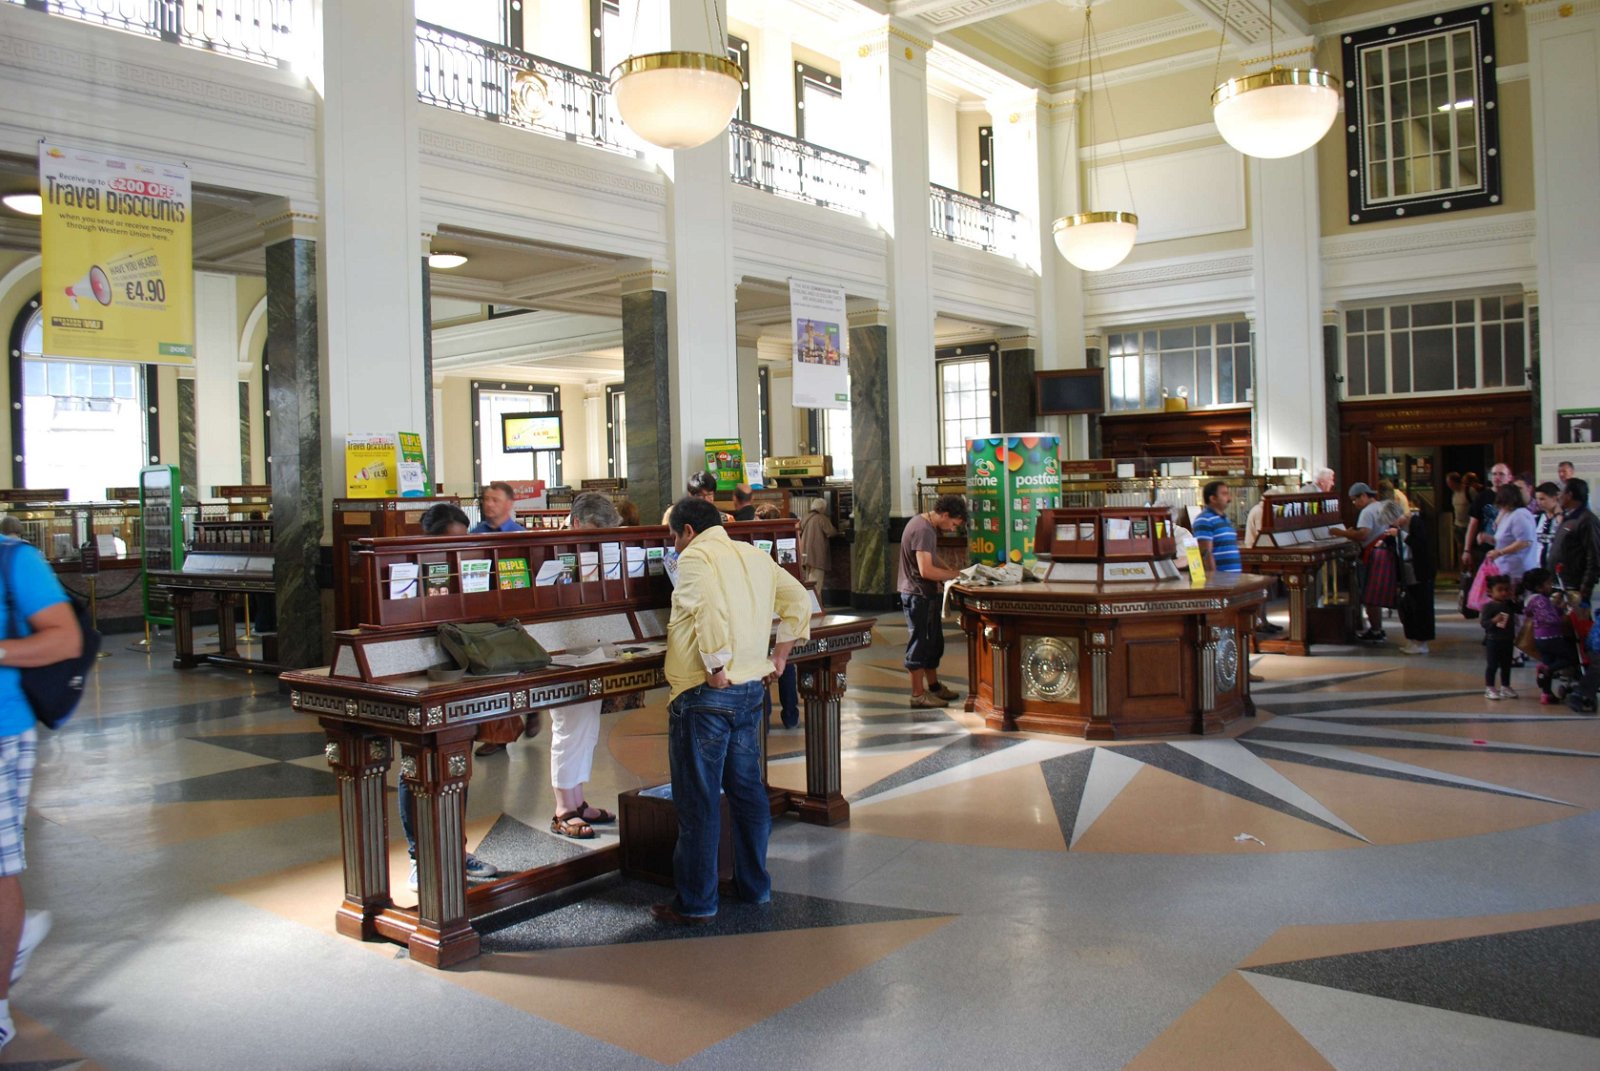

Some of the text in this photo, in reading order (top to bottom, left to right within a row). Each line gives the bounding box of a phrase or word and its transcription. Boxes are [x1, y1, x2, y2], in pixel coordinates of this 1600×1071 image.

[46, 175, 100, 211] Travel
[59, 172, 86, 182] Receive
[87, 178, 96, 186] up
[97, 178, 106, 186] to
[108, 177, 144, 193] €200
[147, 182, 176, 199] OFF
[59, 212, 82, 222] when
[82, 215, 96, 225] you
[97, 217, 115, 226] send
[124, 222, 150, 231] receive
[151, 225, 174, 236] money
[66, 221, 97, 232] through
[98, 225, 129, 236] Western
[129, 229, 150, 238] Union
[125, 278, 166, 303] €4.90
[966, 474, 998, 487] stfone
[1015, 472, 1059, 488] postfone
[969, 536, 995, 554] ello
